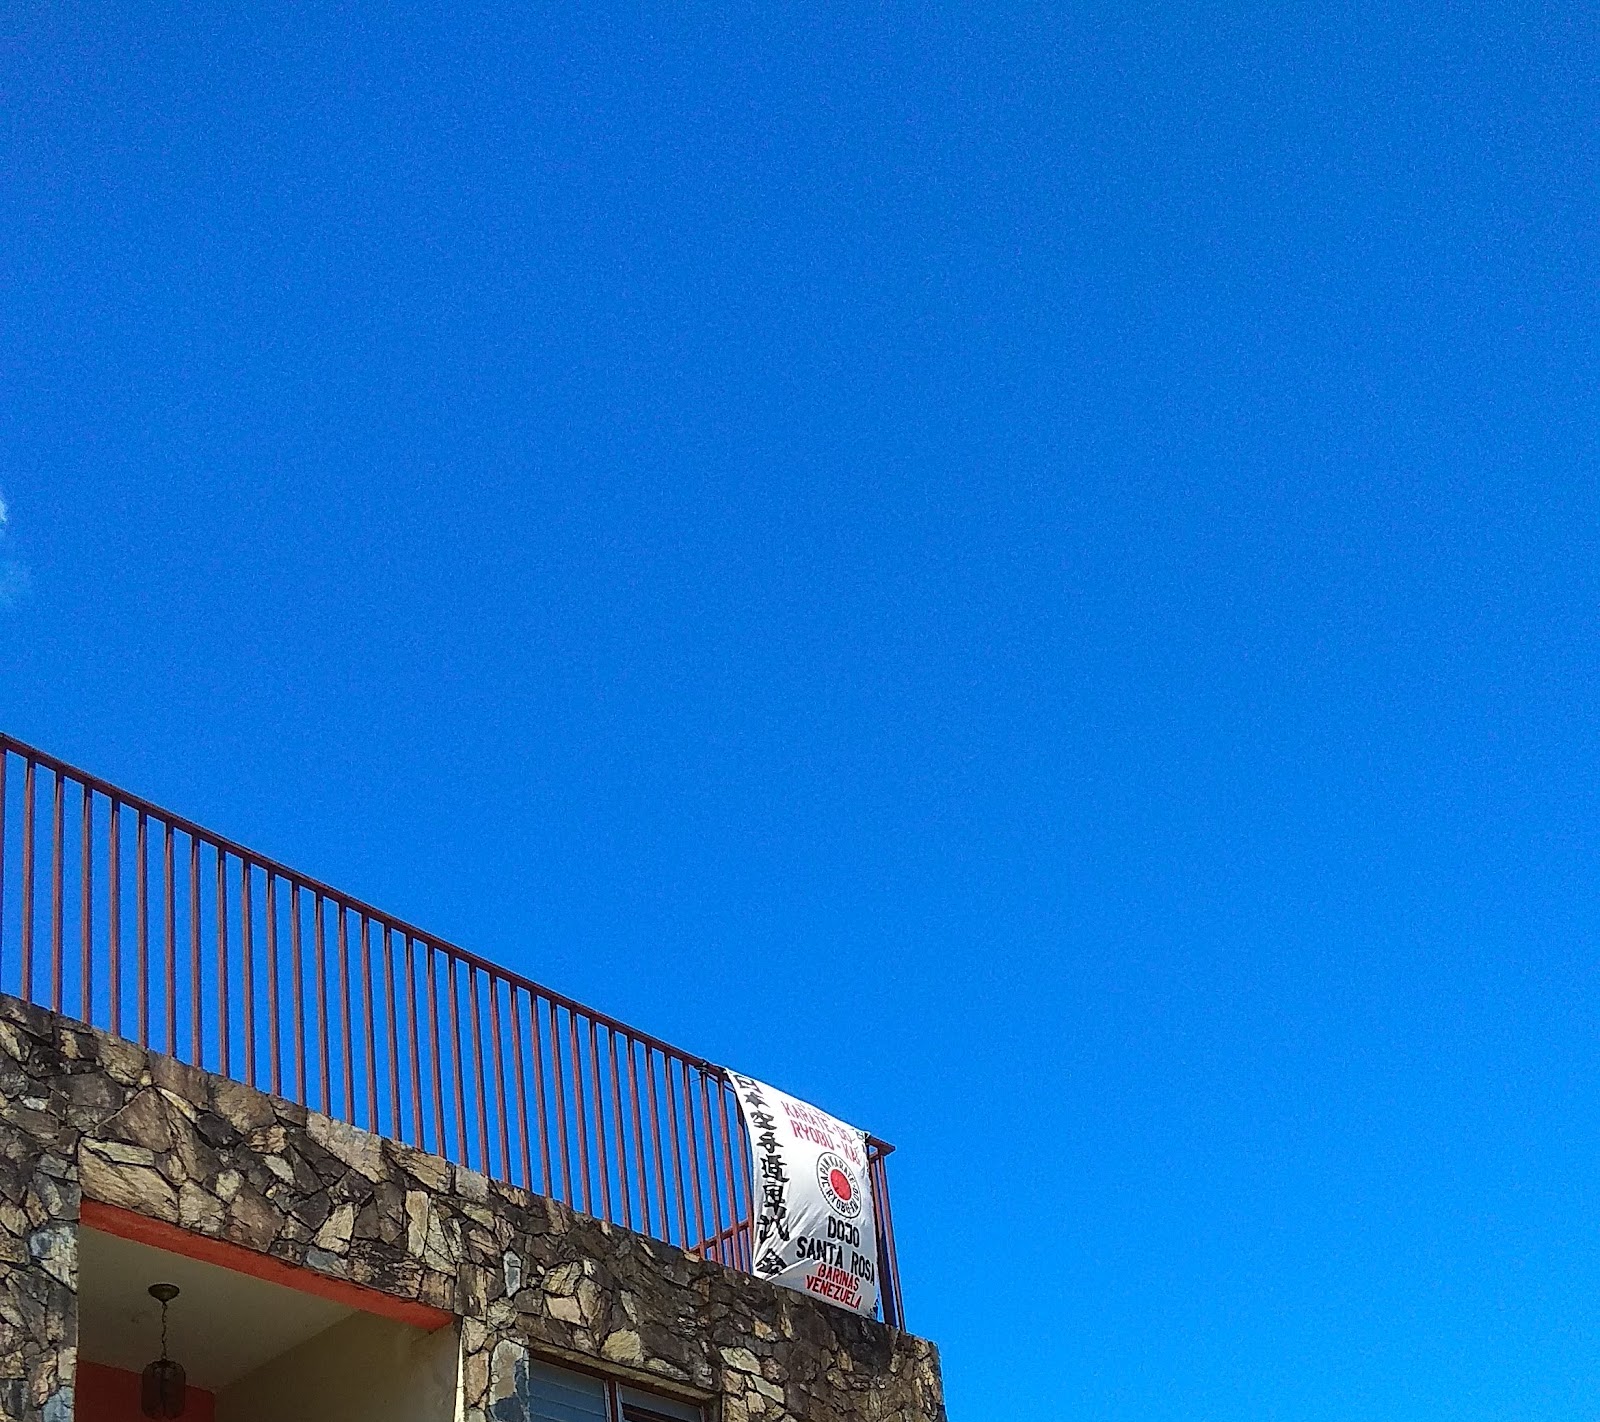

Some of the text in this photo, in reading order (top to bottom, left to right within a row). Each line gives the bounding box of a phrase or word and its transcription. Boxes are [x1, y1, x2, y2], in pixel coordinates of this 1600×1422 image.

[828, 1216, 860, 1248] DOJO
[796, 1236, 875, 1286] SANTA ROSA
[806, 1275, 862, 1310] VENEZUELA
[817, 1264, 860, 1292] BARINAS
